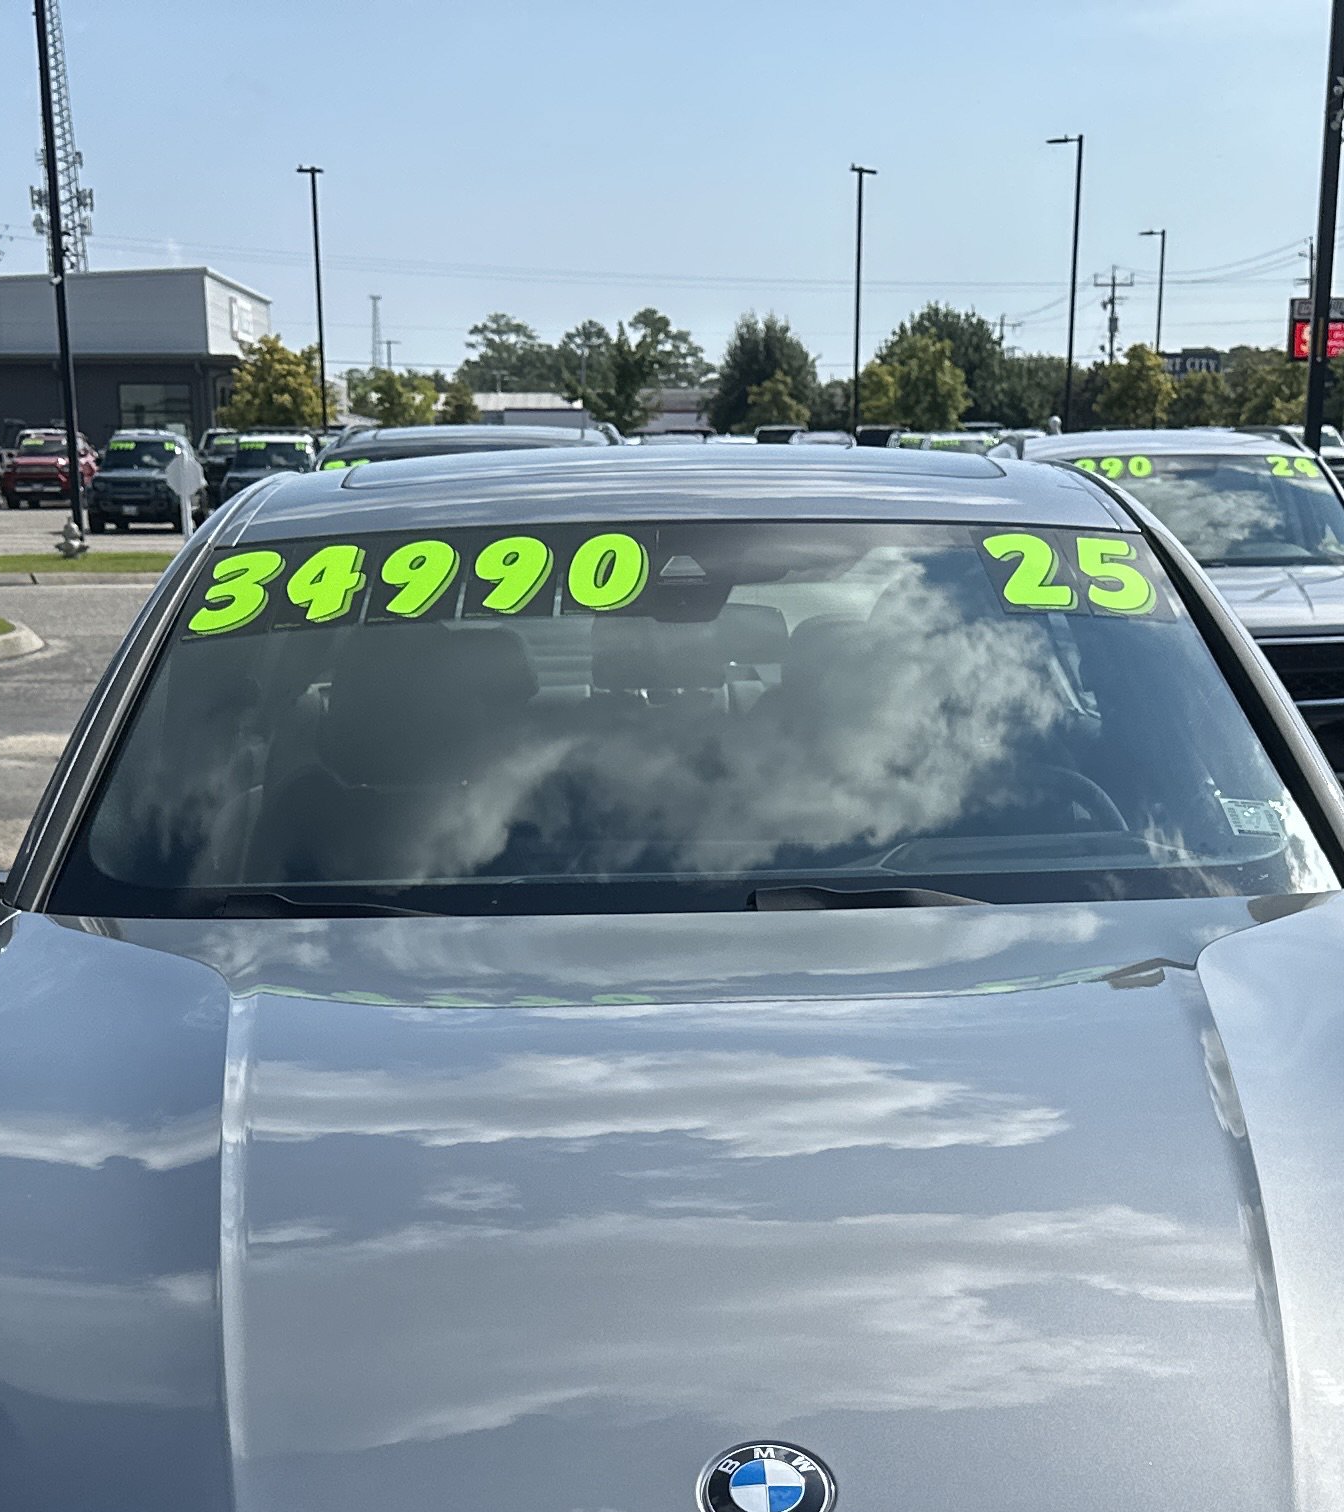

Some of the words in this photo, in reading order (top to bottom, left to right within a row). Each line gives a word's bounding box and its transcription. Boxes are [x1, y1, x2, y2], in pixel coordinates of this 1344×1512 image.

[189, 533, 649, 635] 34990
[983, 533, 1156, 615] 25
[717, 1447, 817, 1475] BMW
